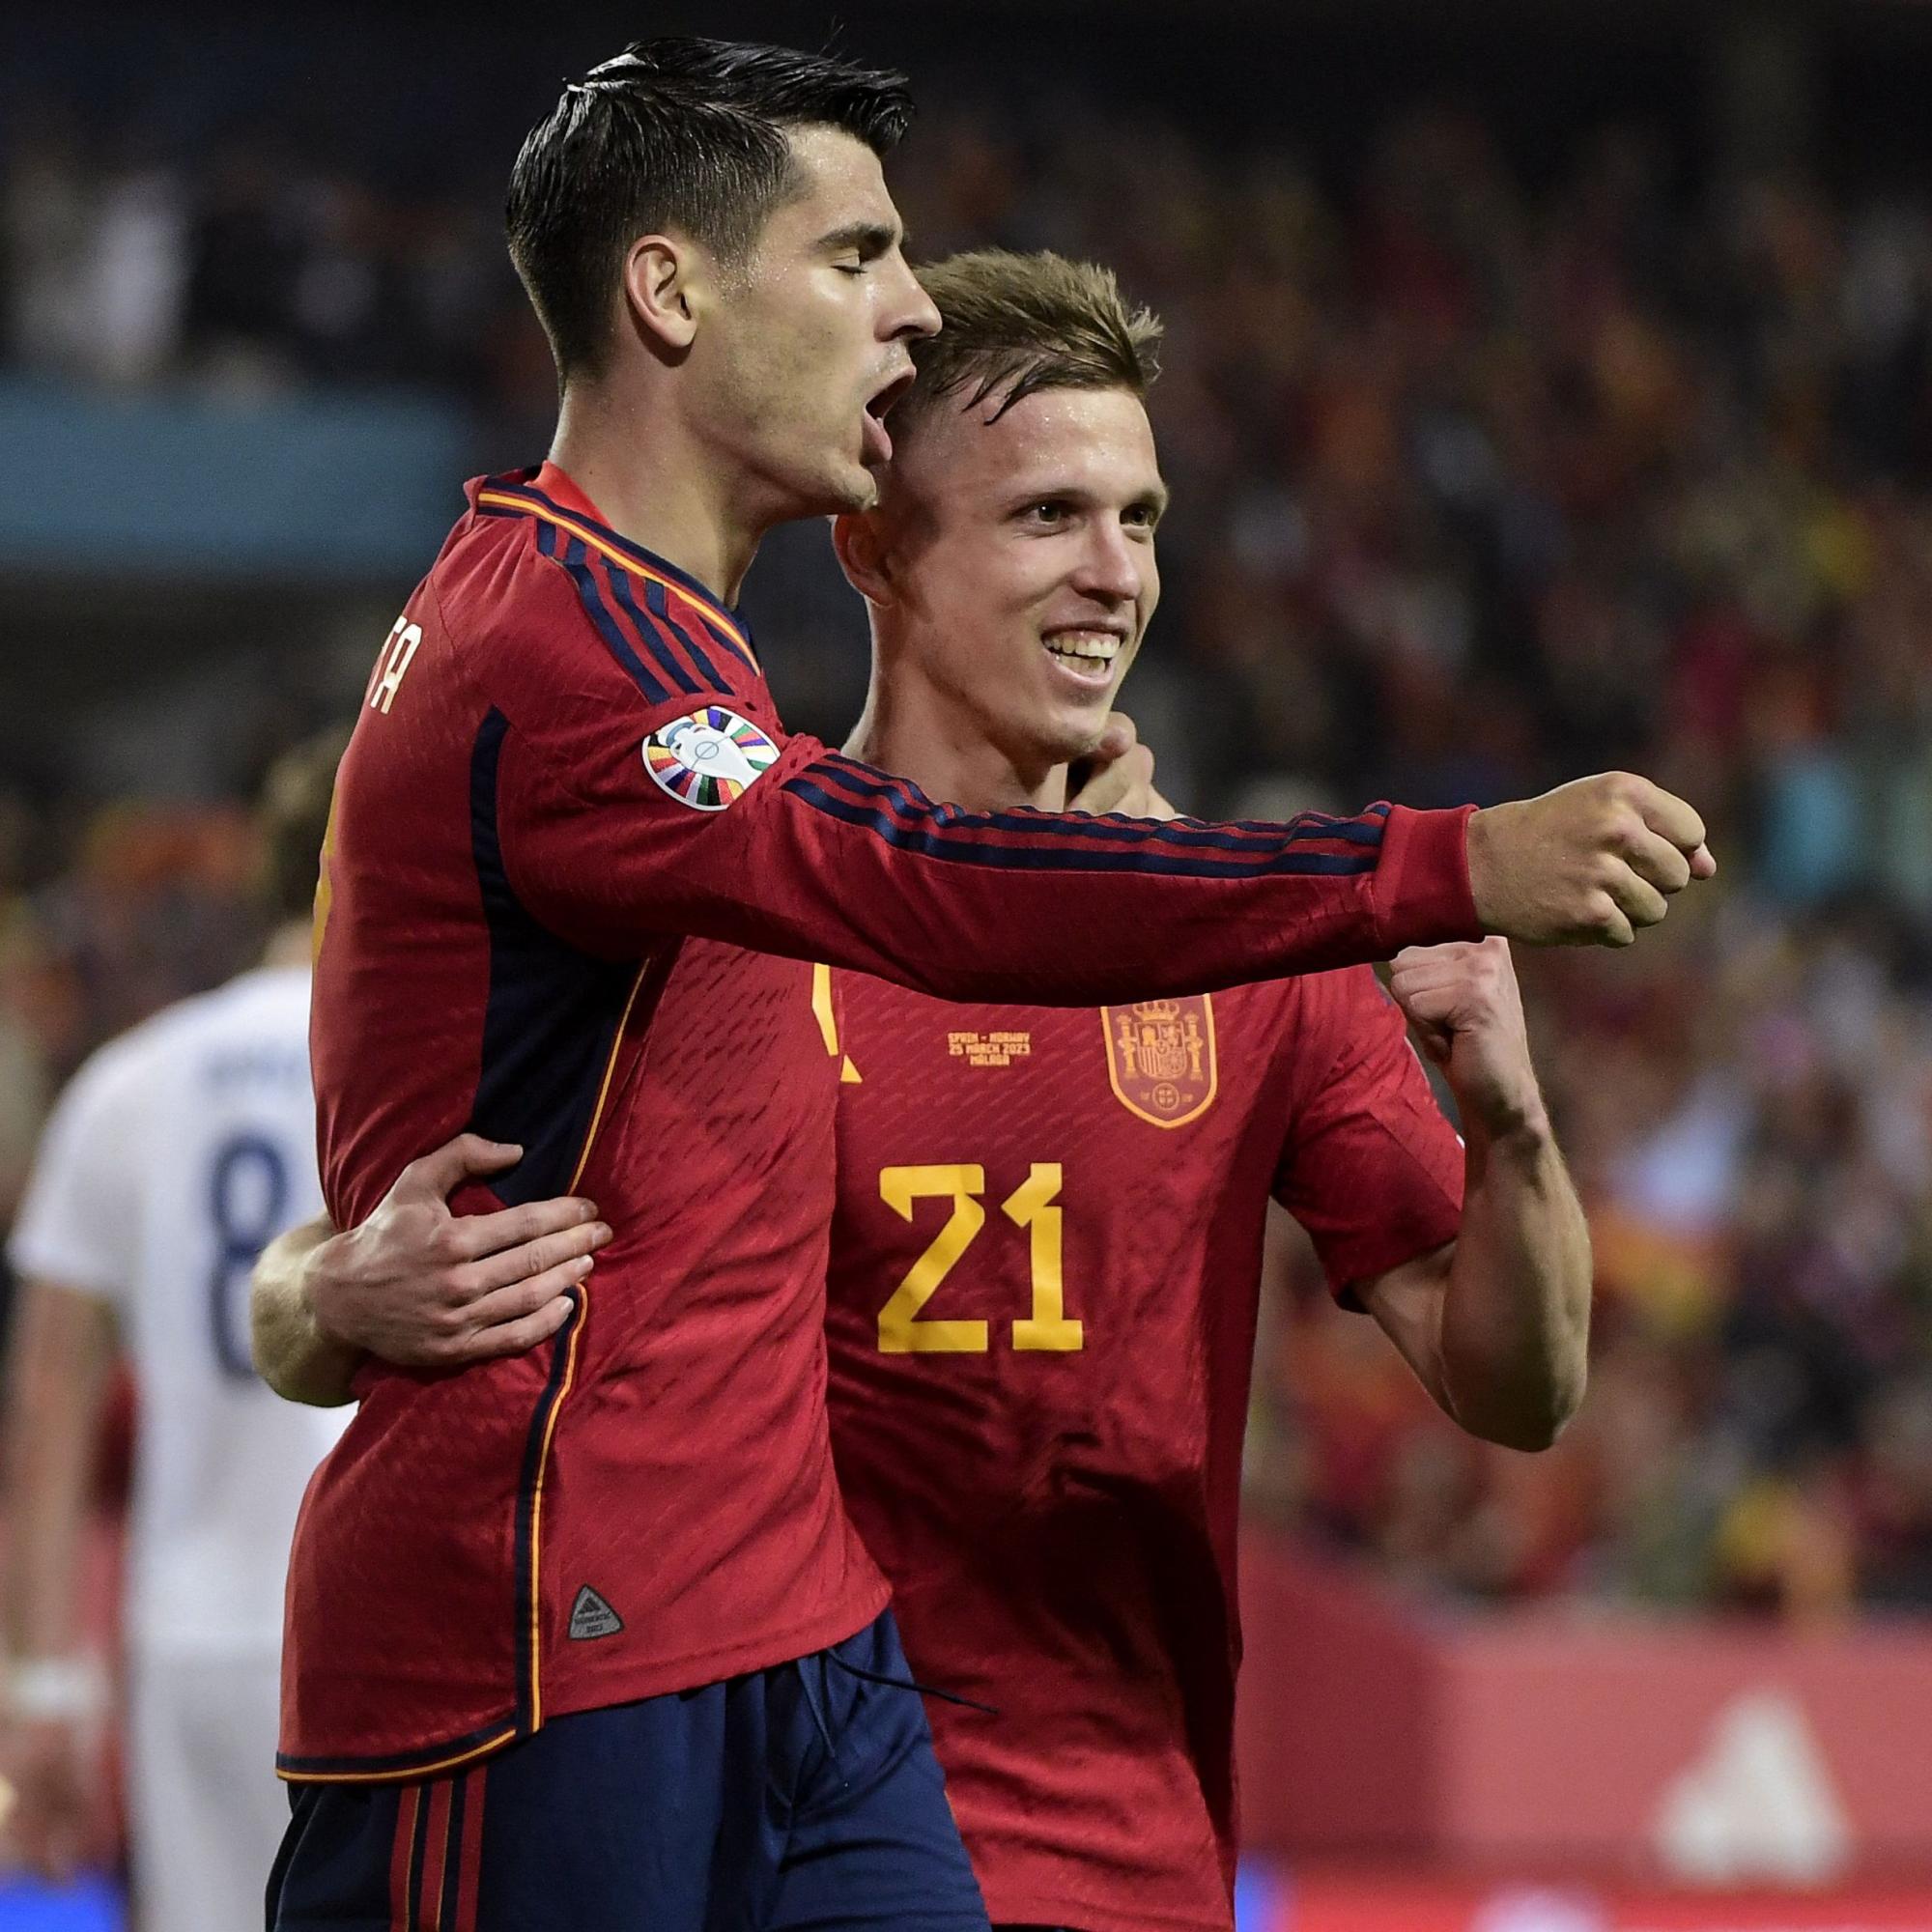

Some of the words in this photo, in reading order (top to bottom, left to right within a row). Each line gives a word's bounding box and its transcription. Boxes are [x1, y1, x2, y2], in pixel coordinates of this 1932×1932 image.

[948, 1033, 979, 1043] SPAIN
[989, 1033, 1030, 1043] NORWAY
[950, 1043, 964, 1055] 25
[966, 1043, 1000, 1054] MARCH
[1003, 1043, 1031, 1055] 2023
[210, 1134, 288, 1379] 8
[877, 1162, 1083, 1353] 21
